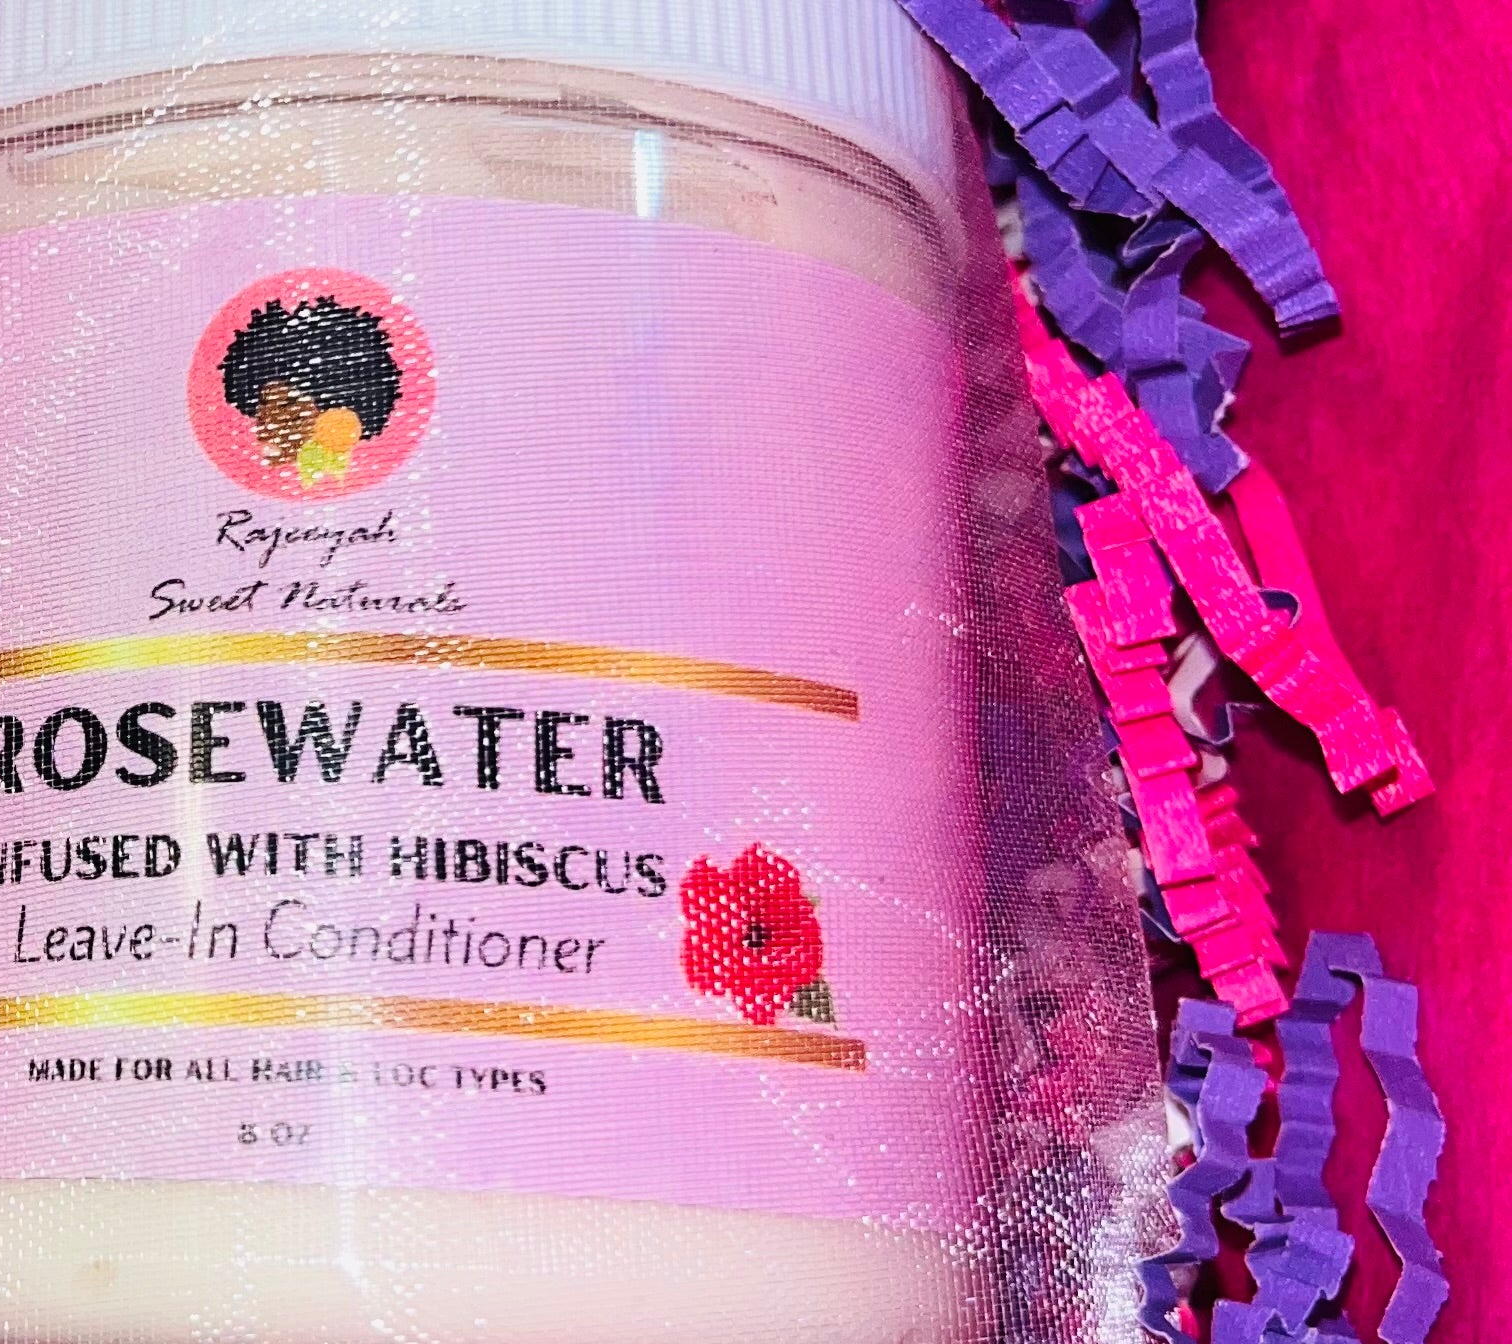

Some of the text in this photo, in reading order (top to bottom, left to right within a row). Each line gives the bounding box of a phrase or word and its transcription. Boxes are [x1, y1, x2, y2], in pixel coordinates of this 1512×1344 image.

[149, 578, 468, 620] Sweet Naturals
[206, 832, 364, 878] WITH
[388, 834, 668, 898] HIBISCUS
[12, 899, 606, 975] Leave-In Conditioner
[28, 1057, 101, 1083] MADE
[115, 1058, 172, 1082] FOR
[186, 1059, 238, 1083] ALL
[251, 1057, 322, 1082] HAIR
[452, 1065, 548, 1095] TYPES
[237, 1121, 258, 1144] 8
